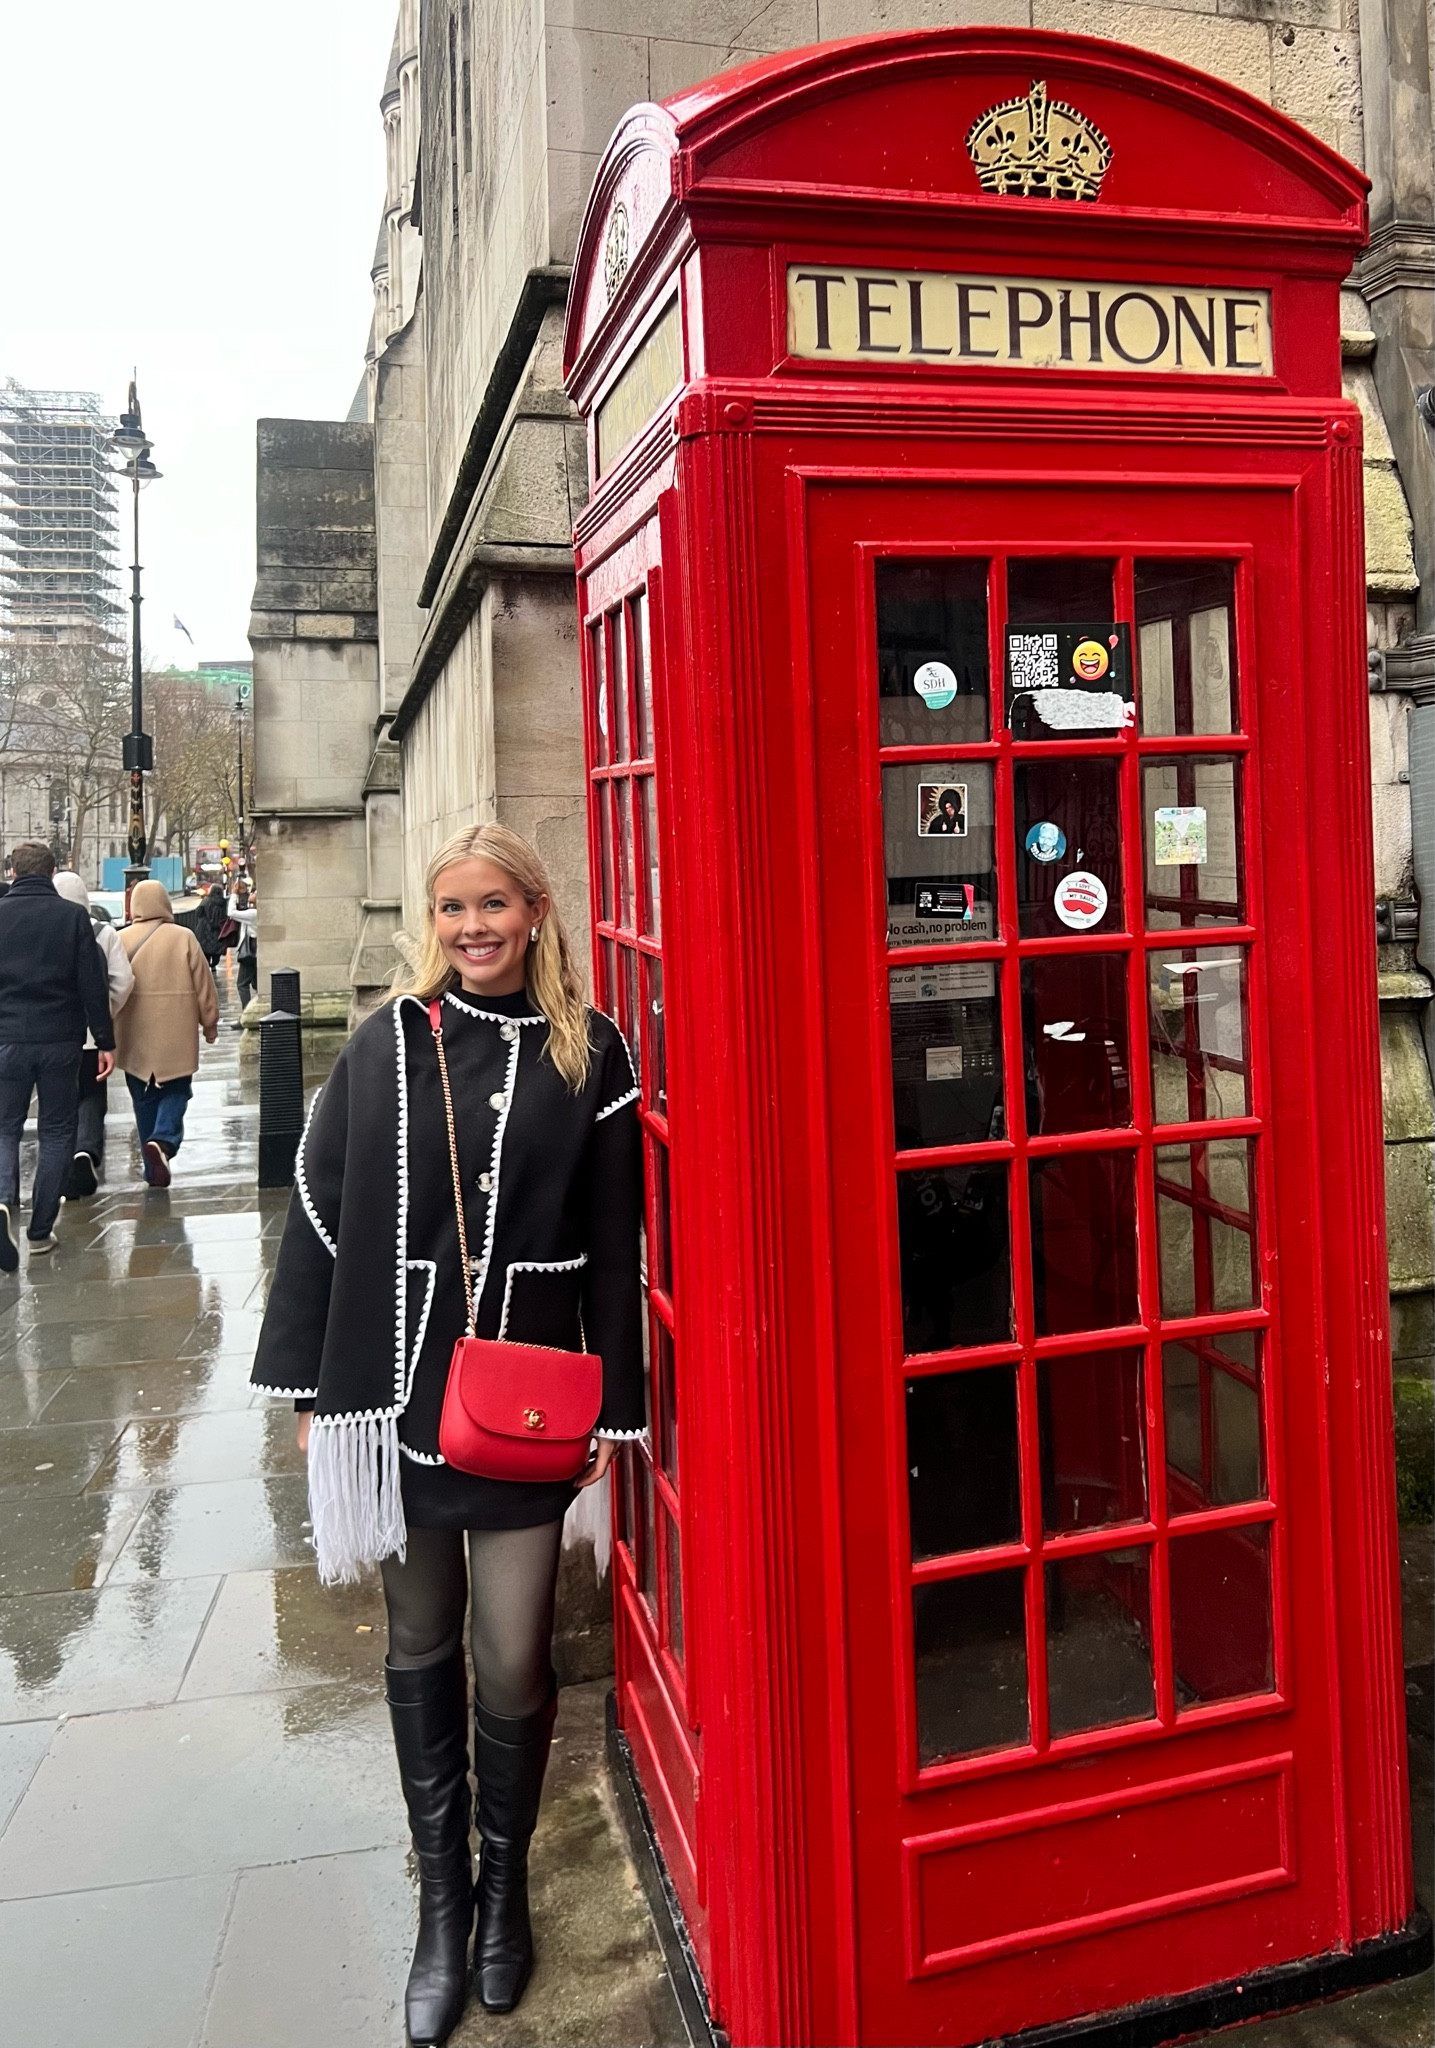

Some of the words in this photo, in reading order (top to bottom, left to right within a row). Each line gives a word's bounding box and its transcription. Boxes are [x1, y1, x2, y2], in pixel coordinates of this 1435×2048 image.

[795, 273, 1263, 369] TELEPHONE
[923, 678, 945, 690] SDH
[944, 920, 987, 934] problem
[904, 974, 916, 983] call
